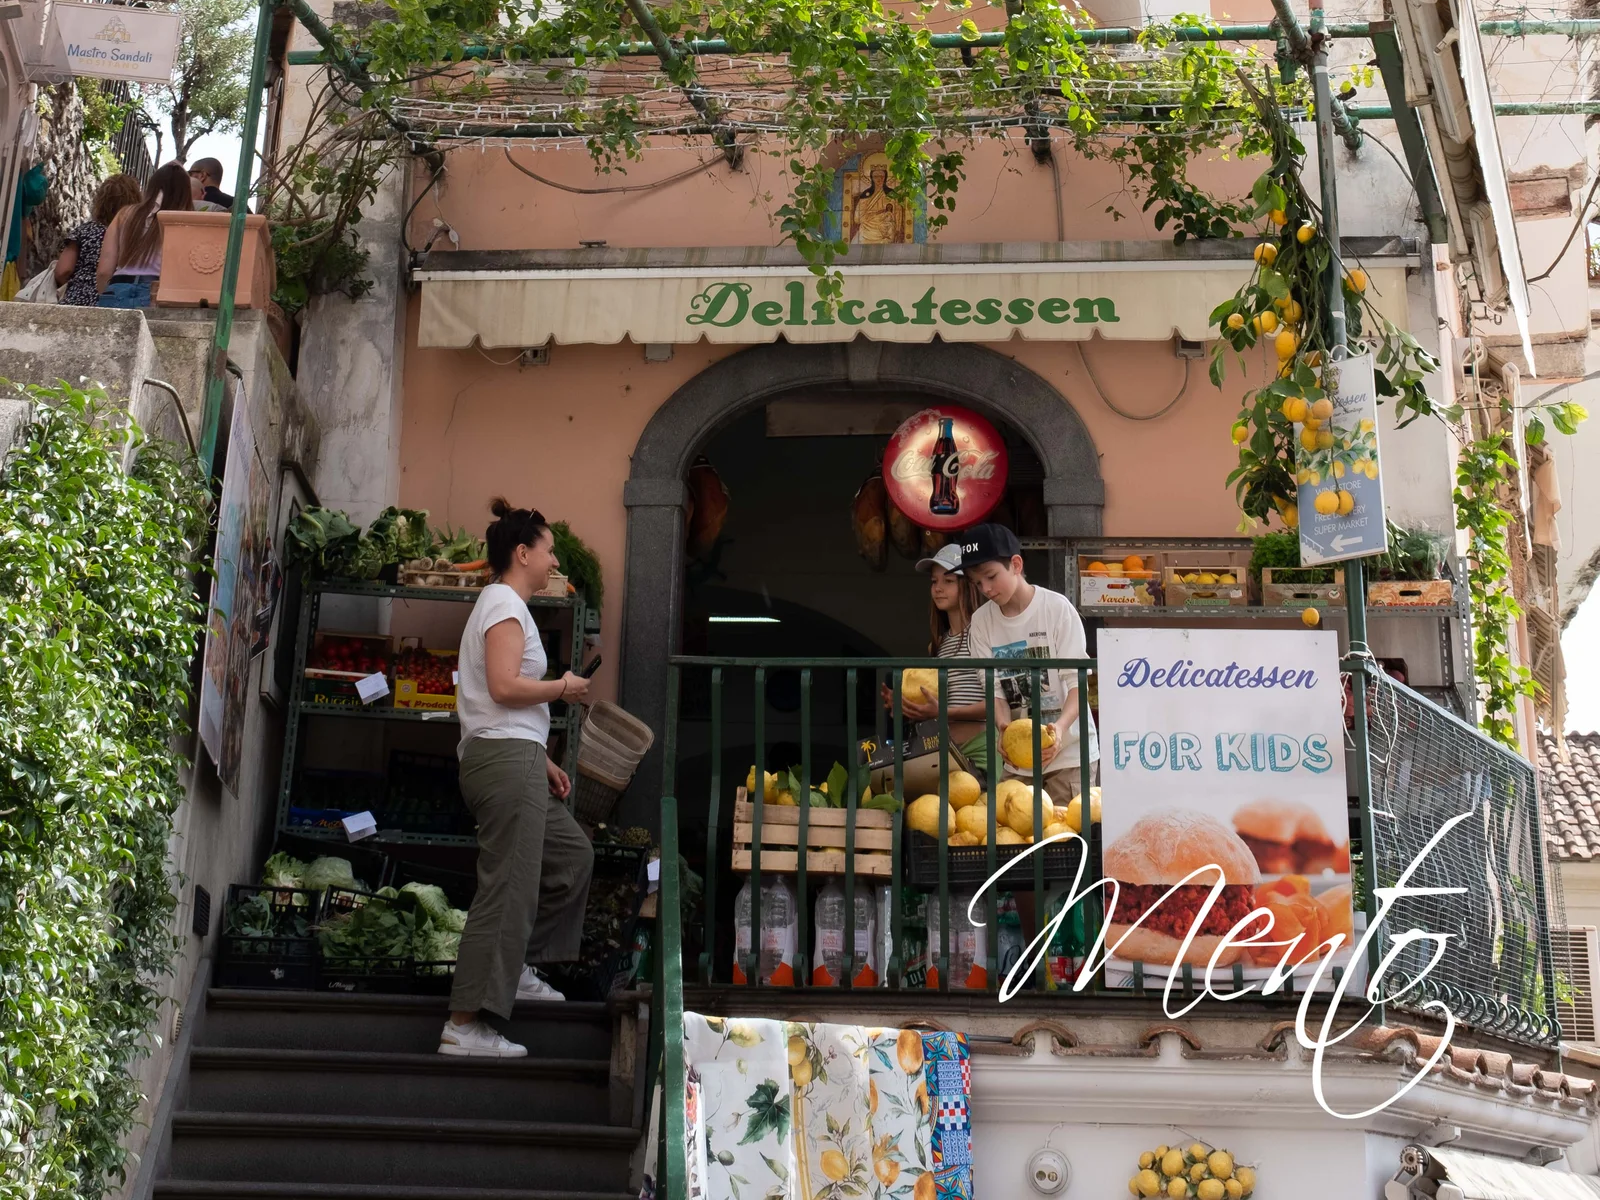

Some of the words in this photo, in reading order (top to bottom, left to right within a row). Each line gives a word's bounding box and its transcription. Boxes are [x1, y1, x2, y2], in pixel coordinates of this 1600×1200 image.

[67, 43, 107, 59] Mastro
[111, 48, 153, 63] Sandali
[78, 58, 139, 70] POSITANO
[686, 281, 1120, 327] Delicatessen
[1339, 480, 1361, 490] STORE
[1314, 523, 1336, 535] SUPER
[1338, 516, 1368, 531] MARKET
[962, 542, 978, 554] FOX
[1098, 594, 1135, 603] Narciso
[1117, 657, 1318, 689] Delicatessen
[1113, 731, 1202, 771] FOR
[1215, 733, 1333, 774] KIDS
